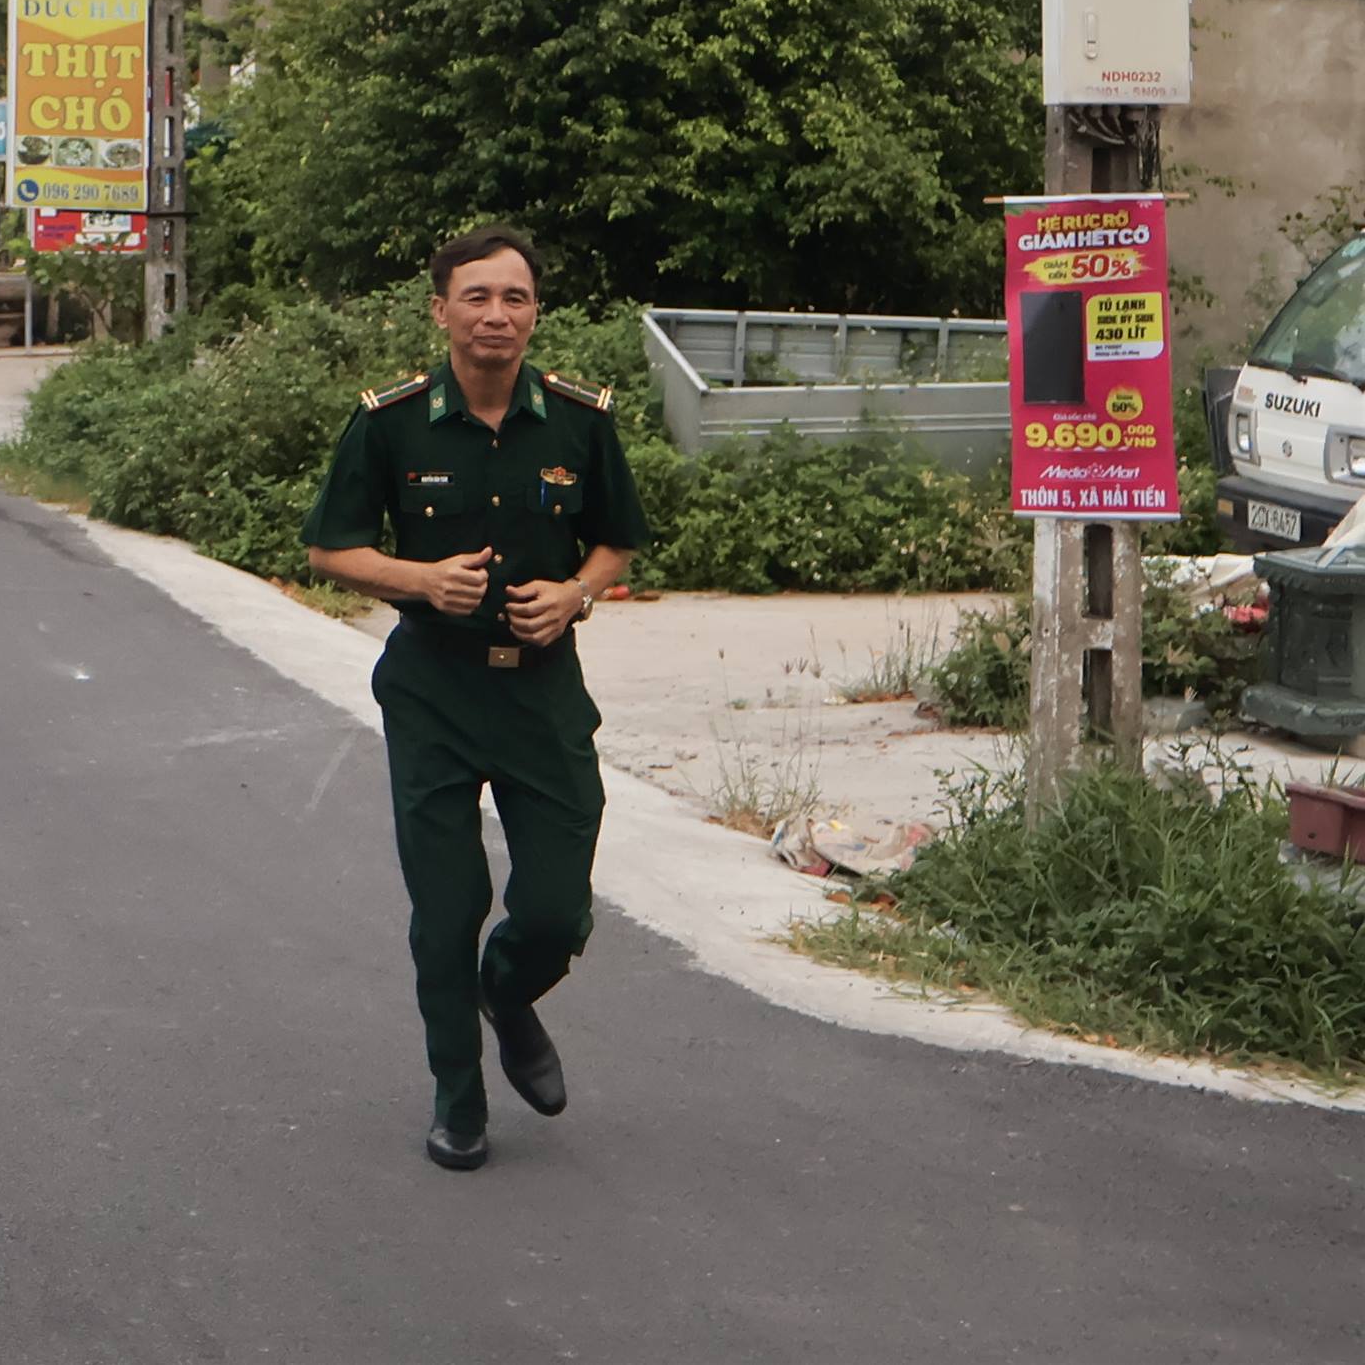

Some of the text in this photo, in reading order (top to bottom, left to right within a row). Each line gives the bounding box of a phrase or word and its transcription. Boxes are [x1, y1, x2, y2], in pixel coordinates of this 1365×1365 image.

[22, 42, 142, 89] THỊT
[1101, 71, 1162, 83] NDH0232
[30, 87, 132, 132] CHÓ
[43, 183, 69, 200] 096
[74, 184, 100, 200] 290
[1018, 231, 1077, 251] GIẢM
[1071, 253, 1132, 279] 50%
[1095, 327, 1124, 340] 430
[1264, 392, 1321, 418] SUZUKI
[1024, 422, 1122, 448] 9.690
[1020, 485, 1058, 507] THÔN
[1102, 484, 1128, 507] HẢI
[1132, 485, 1166, 508] TIẾN
